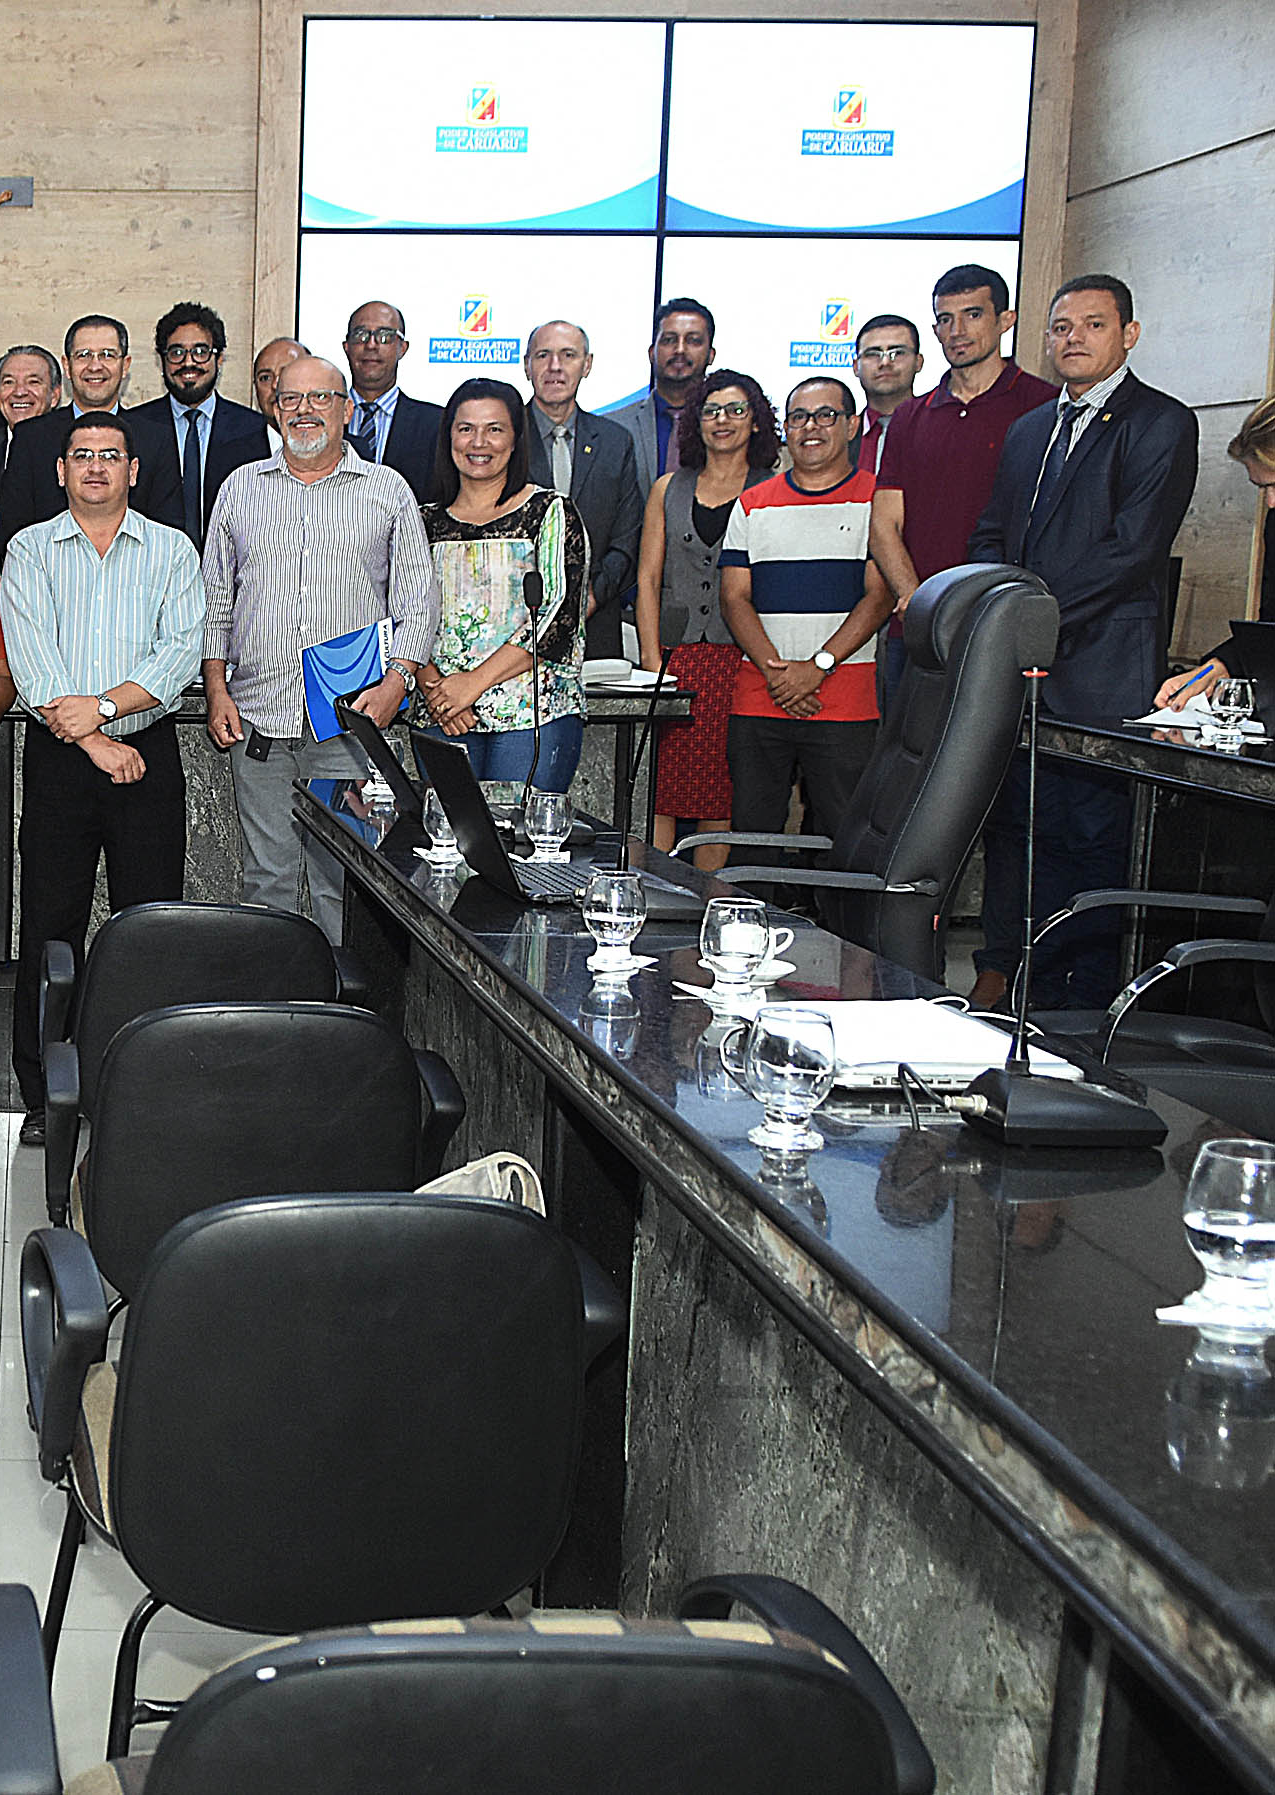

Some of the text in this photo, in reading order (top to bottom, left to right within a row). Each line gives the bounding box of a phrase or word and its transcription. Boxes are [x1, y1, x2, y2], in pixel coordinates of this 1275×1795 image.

[805, 132, 835, 142] PODER
[457, 138, 520, 151] CARUARU
[809, 141, 884, 154] DE CARUARU
[432, 340, 517, 350] PODER LEGISLATIVO
[792, 344, 822, 354] PODER
[436, 349, 510, 361] DE CARUARU
[797, 352, 855, 366] DE CARUA
